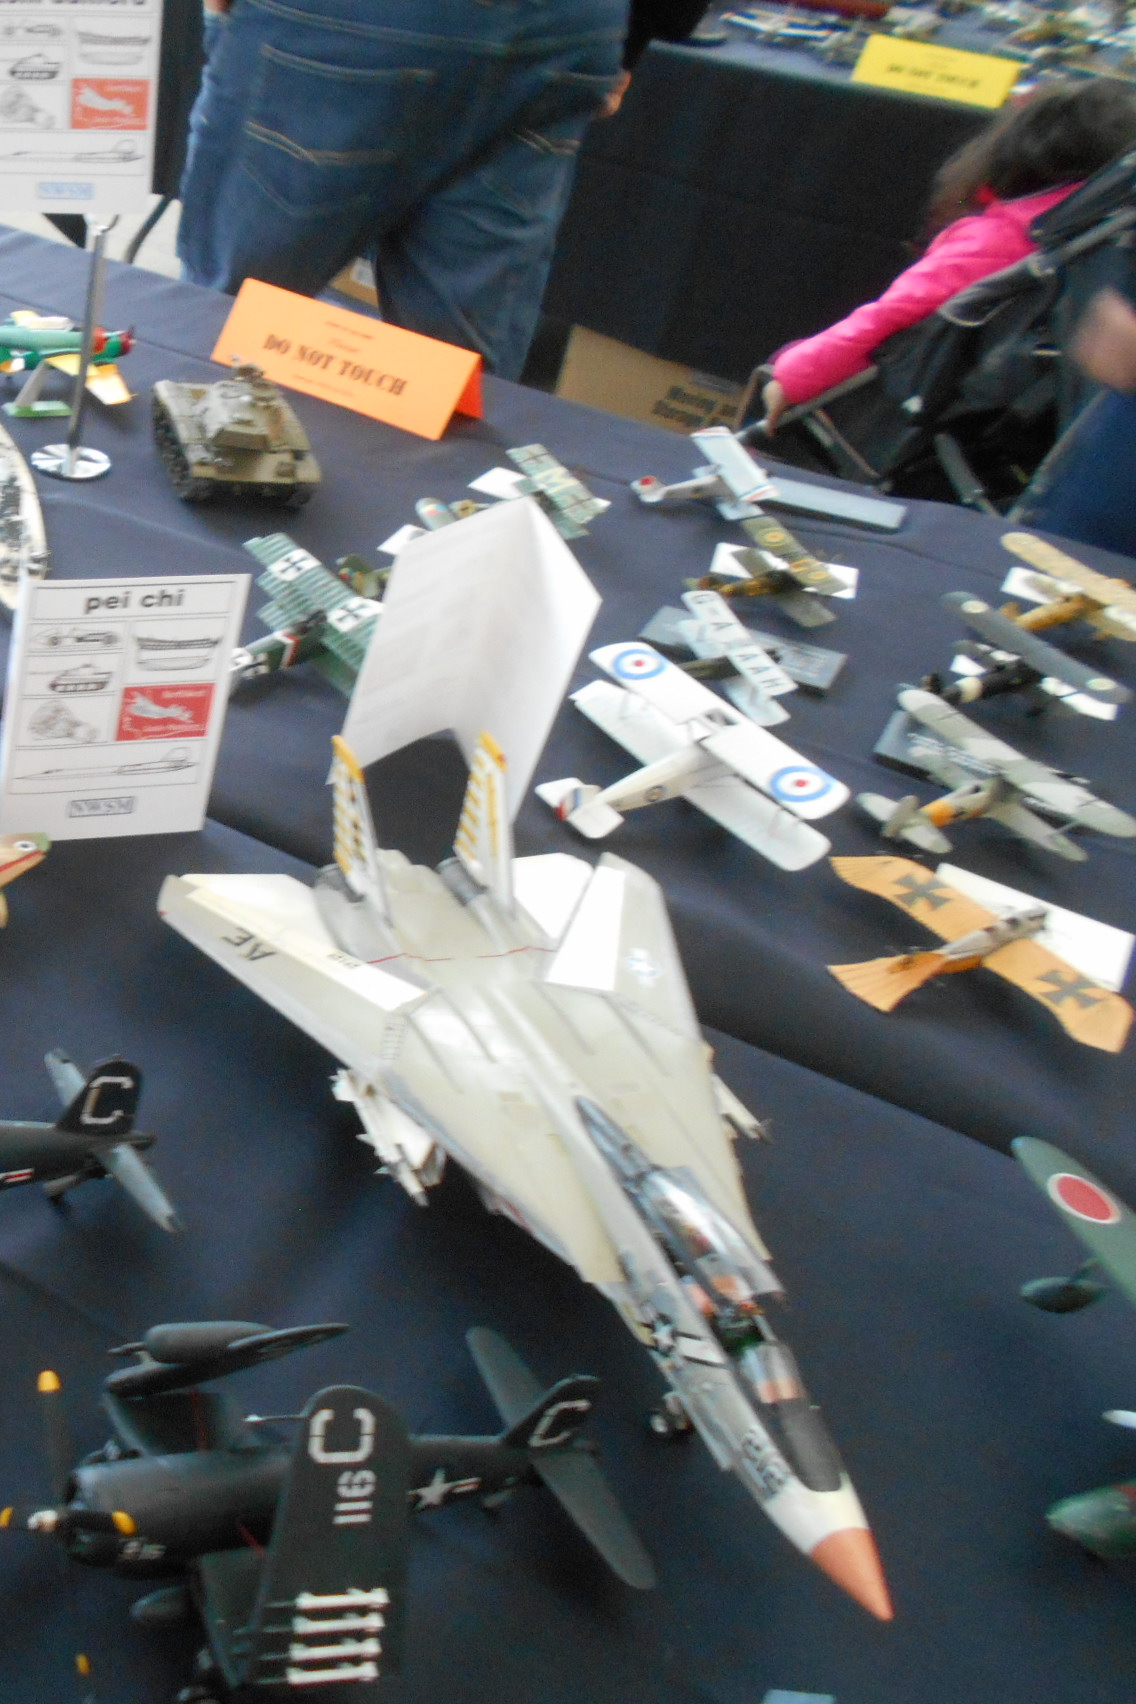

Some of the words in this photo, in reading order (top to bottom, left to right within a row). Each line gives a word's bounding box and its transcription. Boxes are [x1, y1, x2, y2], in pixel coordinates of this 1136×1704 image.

[263, 333, 292, 355] DO
[293, 344, 334, 370] NOT
[337, 359, 408, 396] TOUCH
[84, 591, 130, 614] pei
[140, 589, 185, 608] chi
[80, 1075, 134, 1125] C
[308, 1407, 376, 1464] C
[528, 1399, 592, 1447] C
